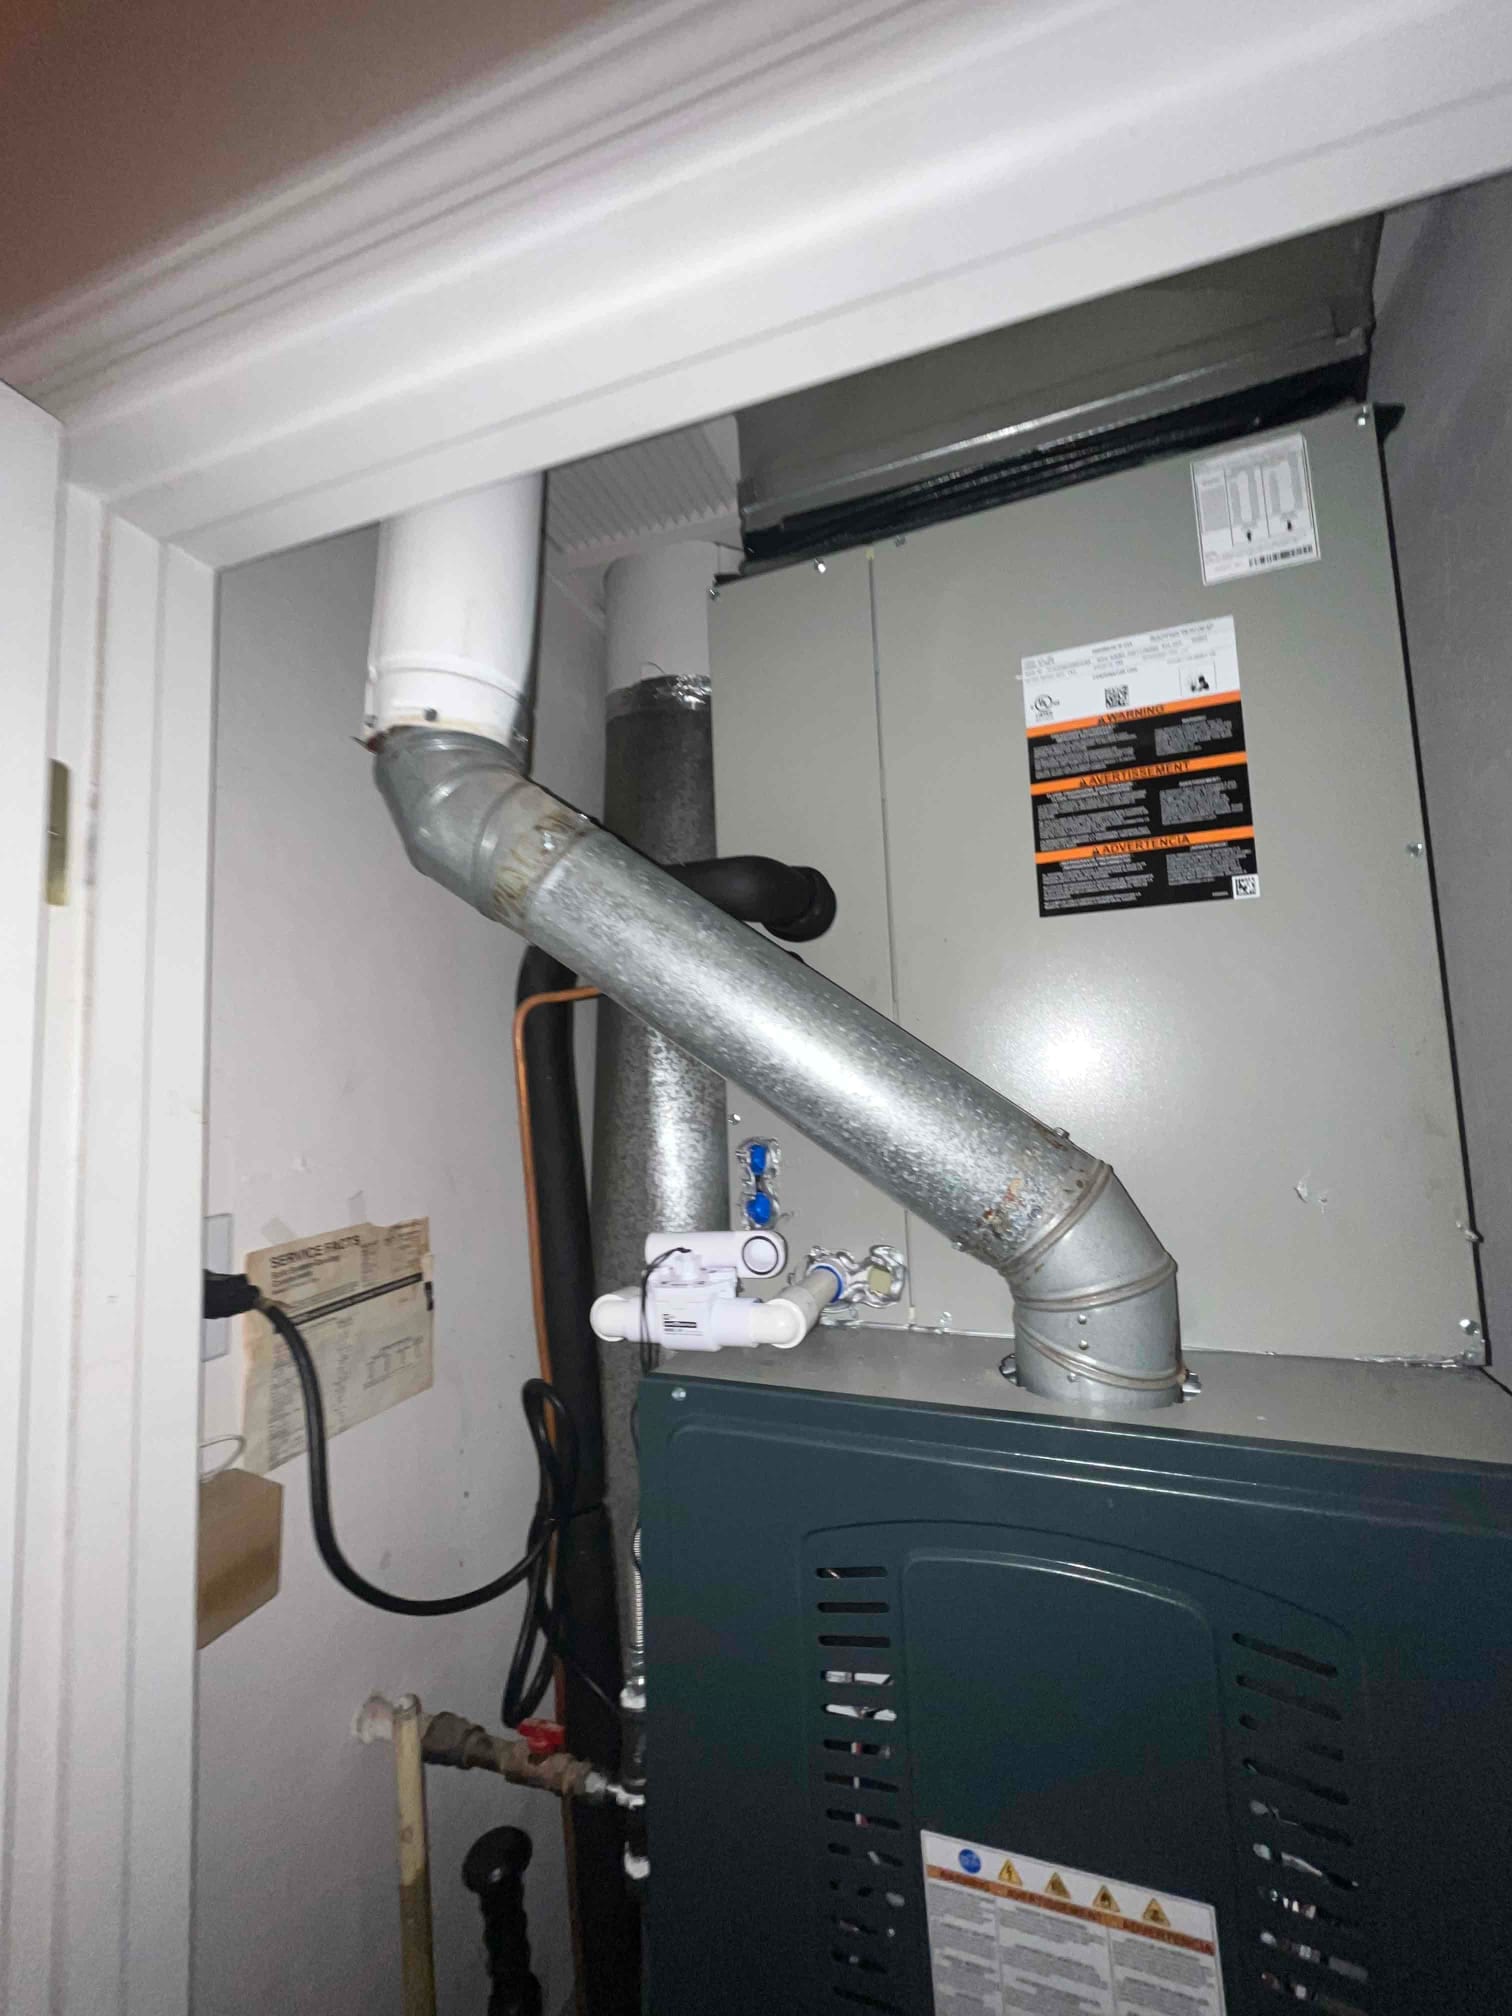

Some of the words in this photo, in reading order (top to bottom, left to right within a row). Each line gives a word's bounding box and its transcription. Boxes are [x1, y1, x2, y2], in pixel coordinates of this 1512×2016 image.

[1106, 704, 1165, 722] WARNING
[1089, 762, 1190, 786] AVERTISSEMENT
[1103, 834, 1190, 854] ADVERTENCIA
[271, 1245, 323, 1269] SERVICE
